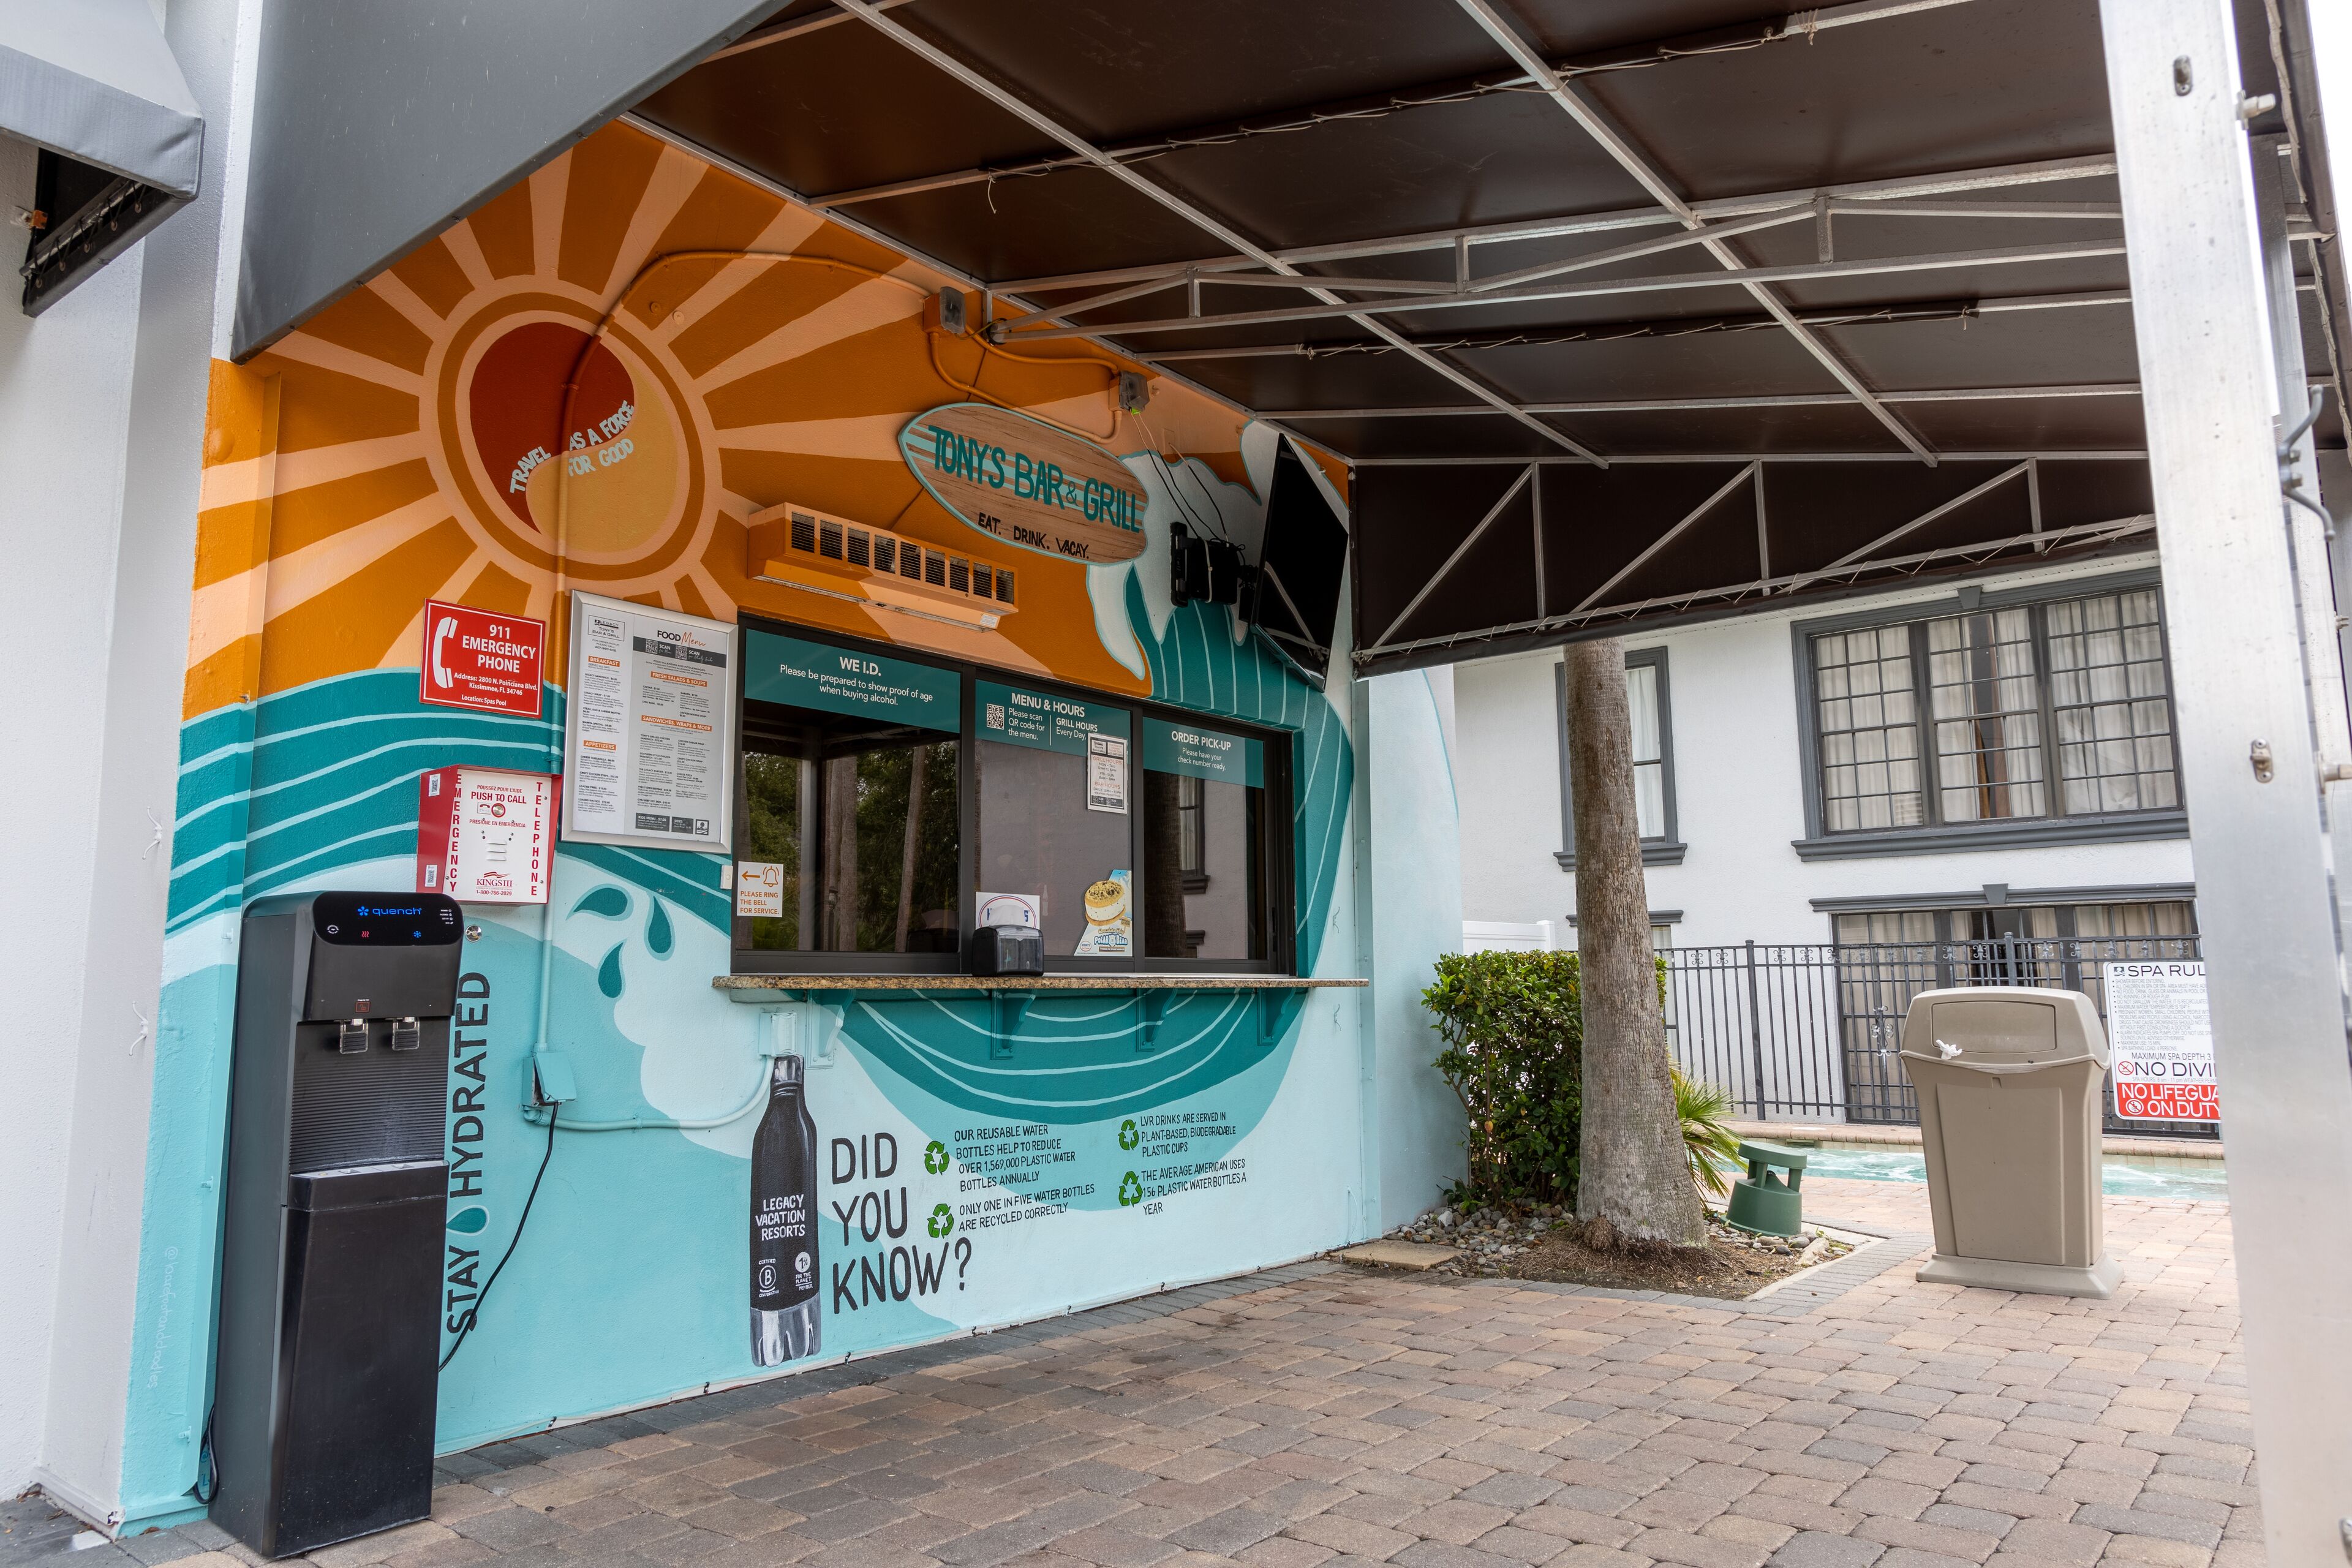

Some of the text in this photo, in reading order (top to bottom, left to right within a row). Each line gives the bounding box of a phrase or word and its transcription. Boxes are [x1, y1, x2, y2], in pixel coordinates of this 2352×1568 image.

[510, 400, 635, 494] TRAVEL AS A FORCE
[598, 438, 634, 467] GOOD
[928, 425, 1140, 533] TONY'S BAR & GRILL
[978, 512, 1089, 559] EAT. DRINK. VACAY.
[489, 624, 510, 639] 911
[657, 630, 706, 647] FOOD Menu
[462, 635, 536, 659] EMERGENCY
[478, 654, 520, 673] PHONE
[590, 657, 619, 666] BREAKFAST
[839, 657, 881, 676] WE I.D.
[454, 673, 478, 681] Address:
[499, 679, 524, 688] Poinciana
[469, 682, 499, 693] Kissimmee,
[780, 664, 806, 677] Please
[809, 669, 818, 680] be
[821, 674, 856, 687] prepared
[868, 682, 888, 692] show
[889, 686, 909, 697] proof
[911, 690, 918, 698] of
[920, 693, 933, 702] age
[820, 685, 898, 706] when buying alcohol.
[1009, 708, 1028, 718] Please
[1012, 693, 1085, 718] MENU & HOURS
[643, 716, 675, 725] SANDWICHES,
[1008, 718, 1019, 726] QR
[1020, 720, 1035, 729] code
[1056, 718, 1098, 732] GRILL HOURS
[1056, 727, 1072, 739] Every
[1171, 731, 1231, 751] ORDER PICK-UP
[586, 741, 614, 750] APPETIZERS
[1182, 747, 1198, 757] Please
[1177, 756, 1226, 772] check number ready.
[470, 791, 527, 804] PUSH TO CALL
[450, 774, 462, 892] EMERGENCY
[531, 782, 543, 895] TELEPHONE
[1094, 934, 1128, 945] POLAR BEAR
[2128, 965, 2164, 976] SPA
[2135, 1062, 2216, 1077] NO DIVI
[2122, 1084, 2147, 1099] NO
[2147, 1100, 2220, 1117] ON DUTY
[954, 1125, 1048, 1142] OUR REUSABLE WATER
[447, 972, 490, 1334] STAY HYDRATED
[956, 1138, 1061, 1159] BOTTLES HELP TO REDUCE
[832, 1132, 897, 1185] DID
[959, 1152, 1076, 1174] OVER 1,569,000 PLASTIC WATER
[960, 1171, 1040, 1192] BOTTLES ANNUALLY
[763, 1194, 804, 1212] LEGACY
[960, 1183, 1095, 1215] ONLY ONE IN FIVE WATER BOTTLES
[755, 1209, 805, 1226] VACATION
[832, 1187, 907, 1246] YOU
[959, 1202, 1068, 1232] ARE RECYCLED CORRECTLY
[762, 1224, 805, 1241] RESORTS
[799, 1257, 807, 1269] 1%
[765, 1269, 772, 1285] B
[832, 1237, 972, 1314] KNOW?
